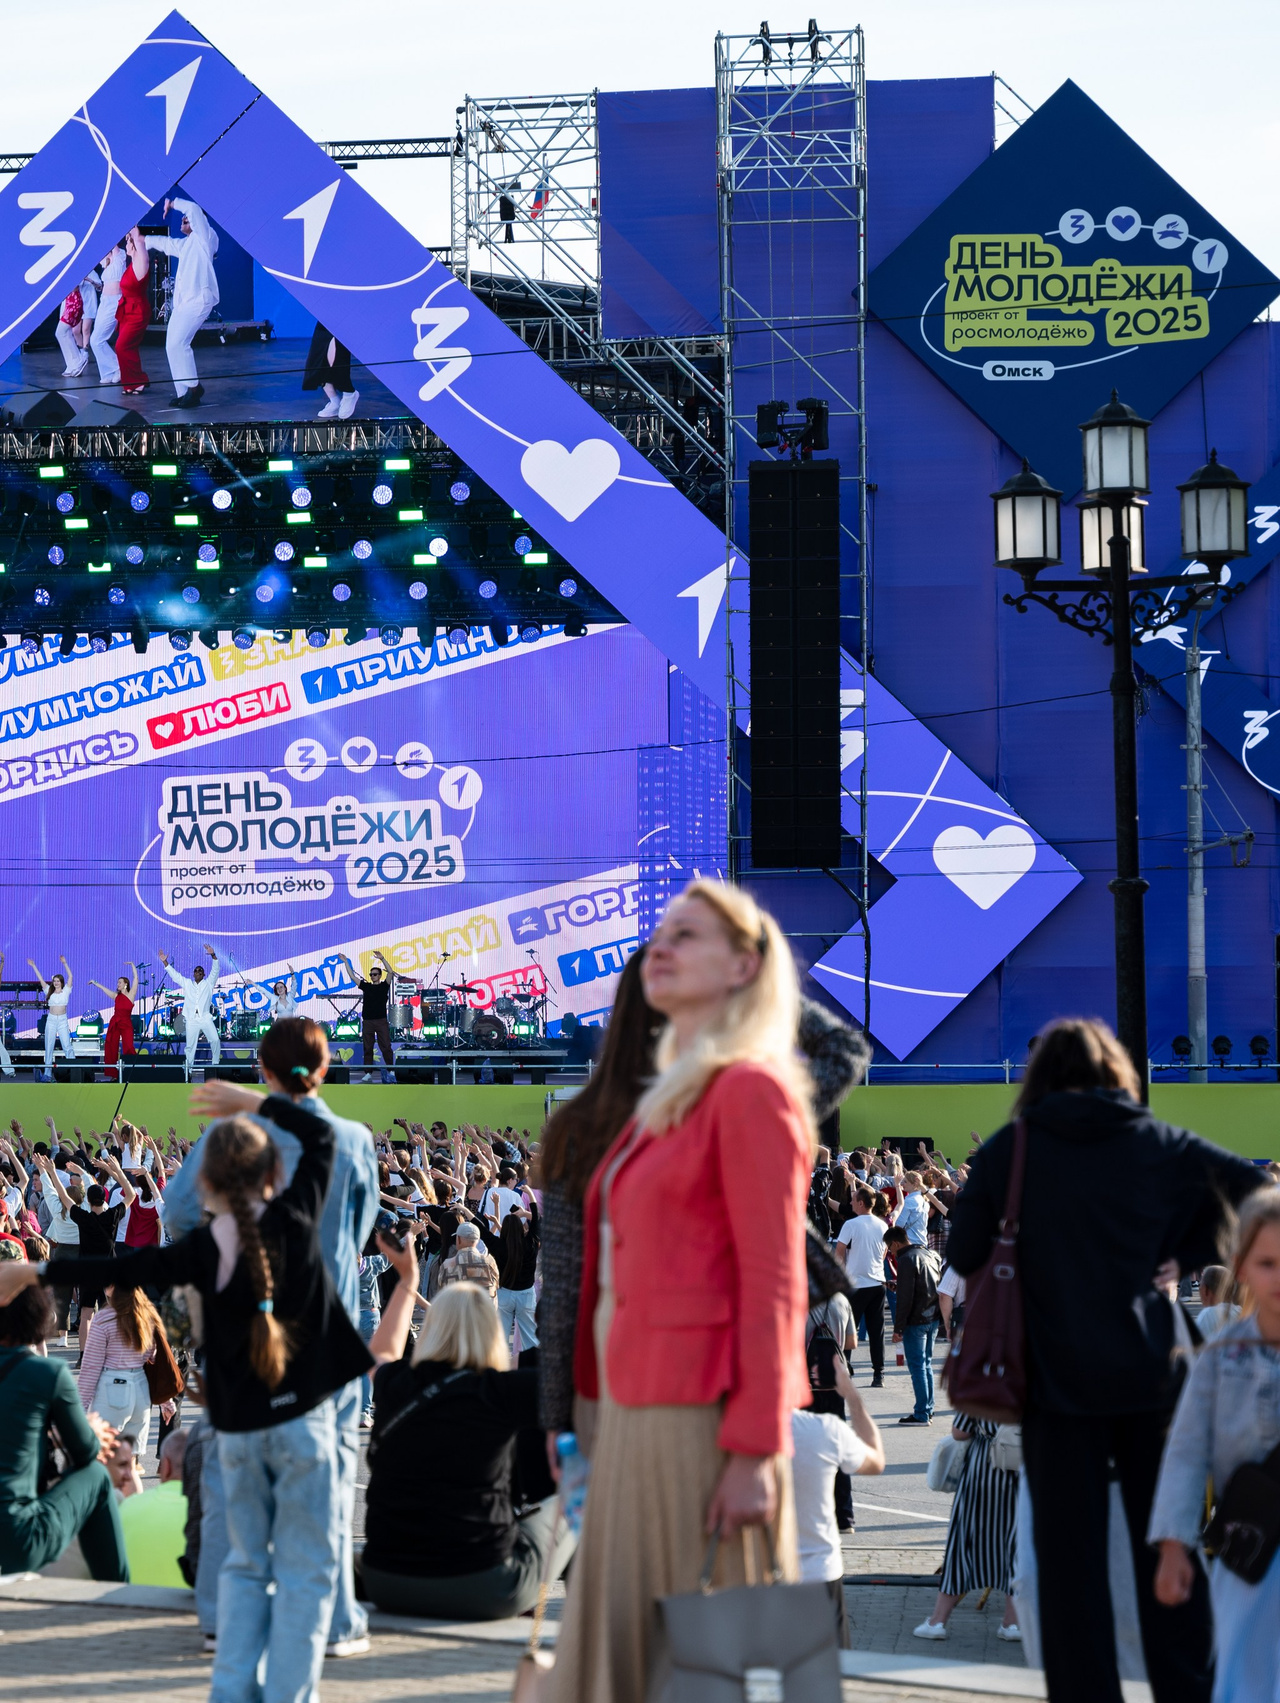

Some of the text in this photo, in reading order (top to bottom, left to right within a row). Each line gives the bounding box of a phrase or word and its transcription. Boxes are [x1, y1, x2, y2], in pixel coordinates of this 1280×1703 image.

[952, 241, 1055, 274] ДЕНЬ
[952, 265, 1183, 306] МОЛОДЁЖИ
[952, 309, 1020, 321] проект от
[1113, 304, 1202, 339] 2025
[952, 324, 1088, 344] росмолодёжь
[991, 364, 1044, 377] Омск
[182, 686, 288, 736] ЛЮБИ
[167, 780, 283, 824] ДЕНЬ
[169, 804, 433, 856] МОЛОДЁЖИ
[170, 863, 247, 879] проект от
[353, 844, 457, 889] 2025
[171, 876, 326, 906] росмолодёжь
[392, 918, 498, 969] ЗНАЙ
